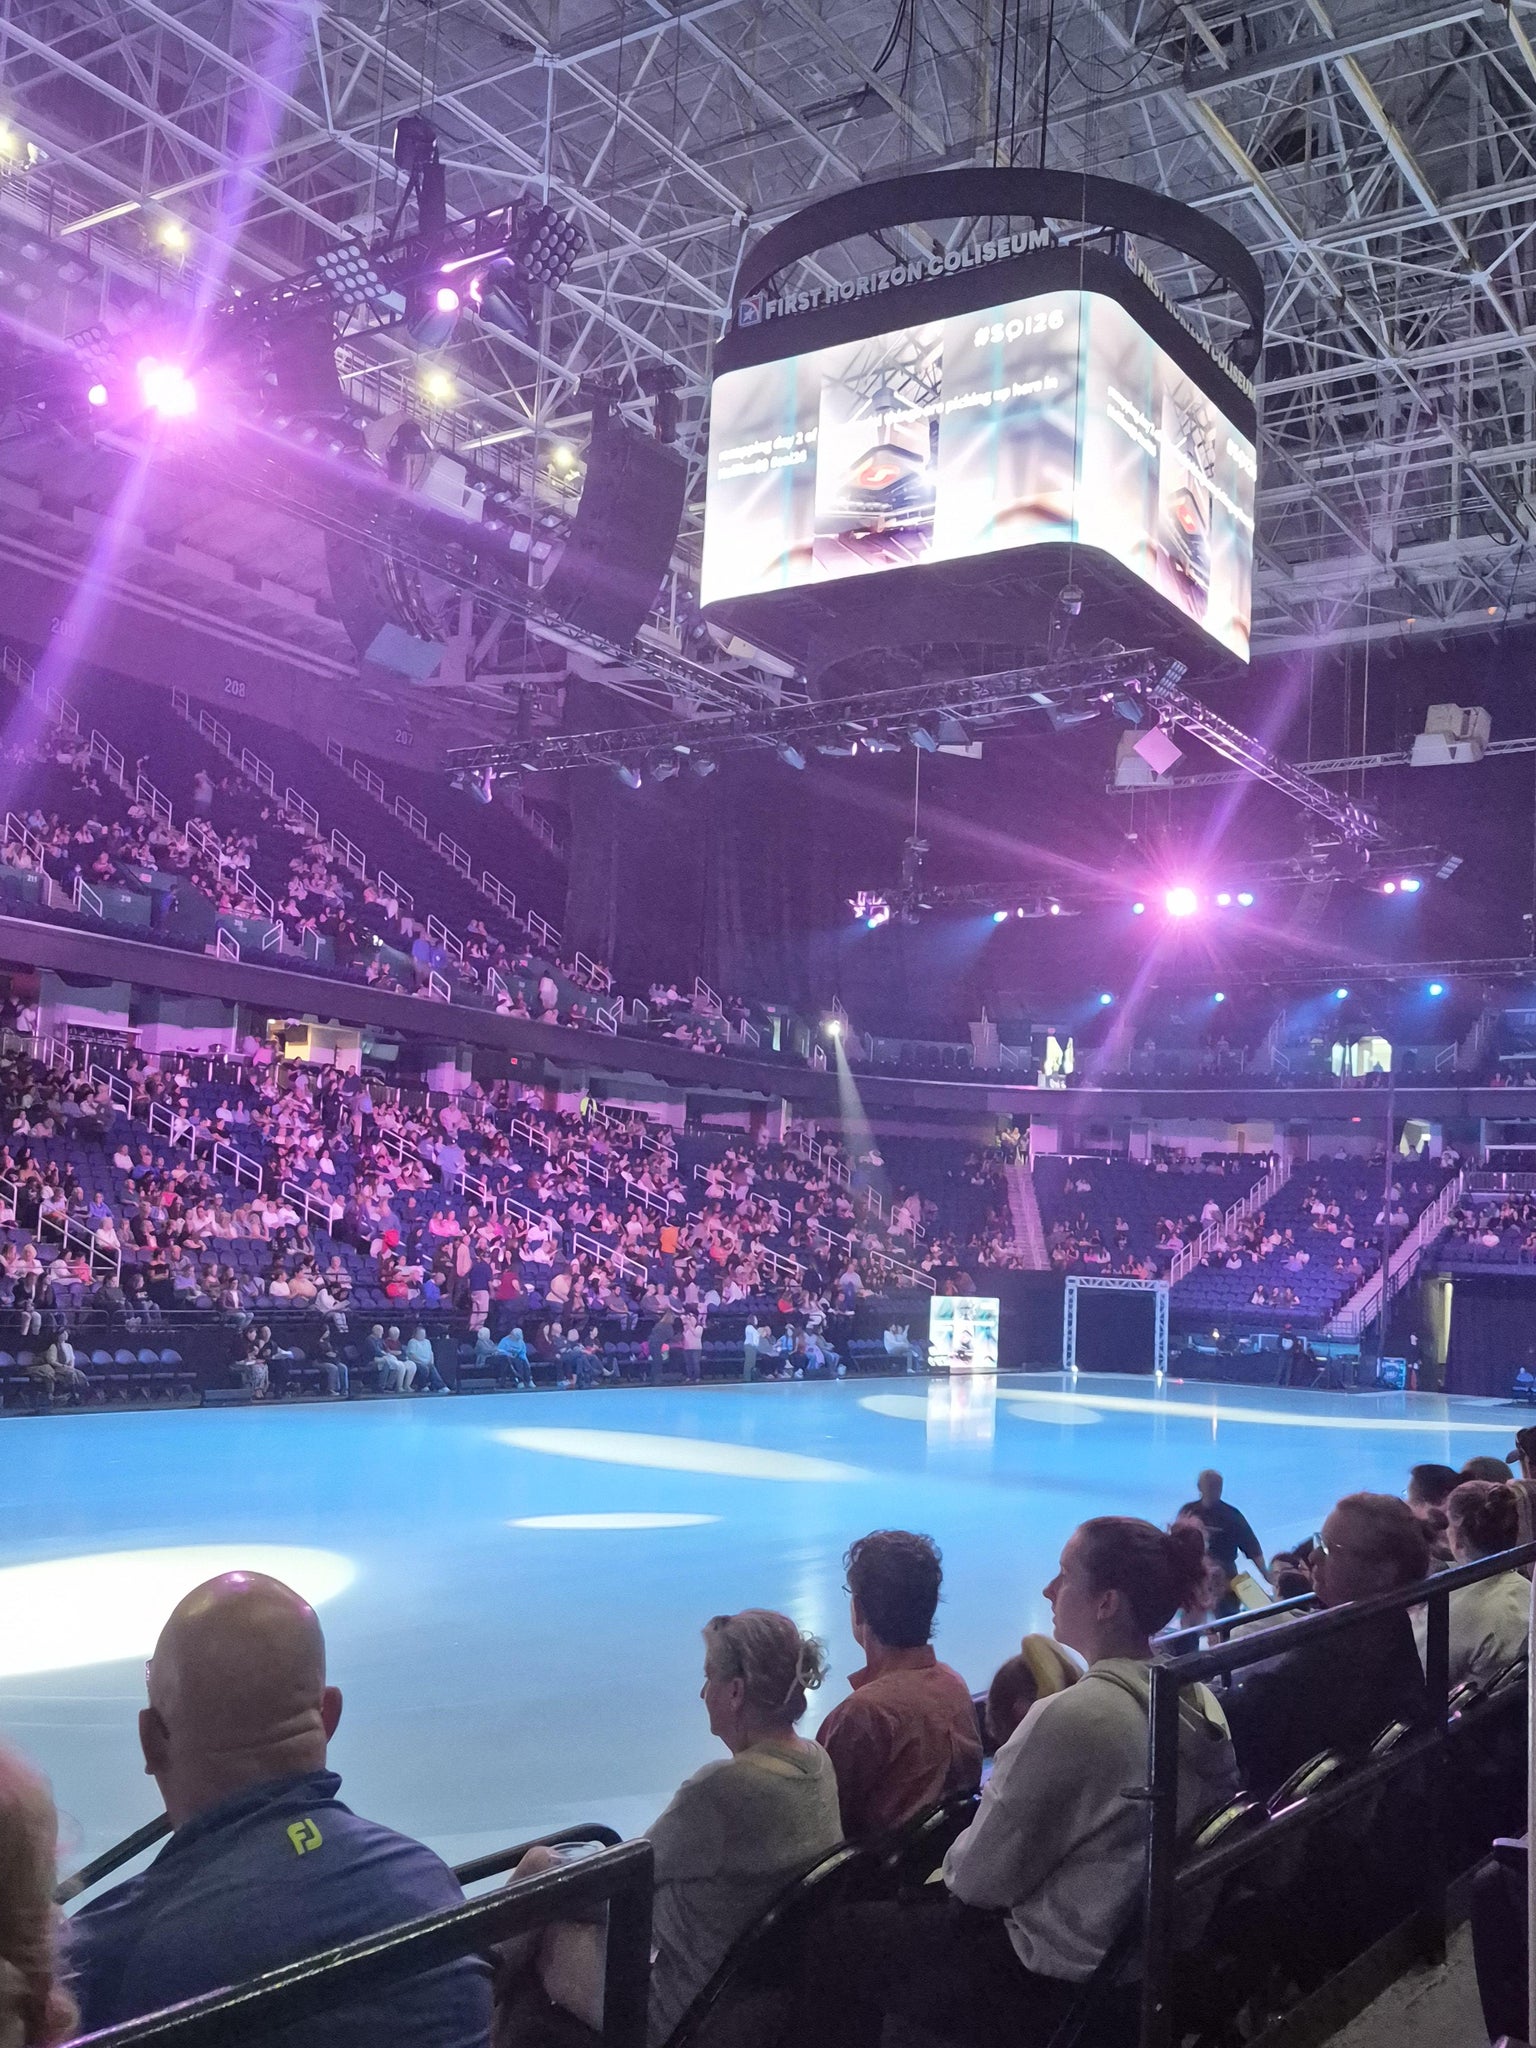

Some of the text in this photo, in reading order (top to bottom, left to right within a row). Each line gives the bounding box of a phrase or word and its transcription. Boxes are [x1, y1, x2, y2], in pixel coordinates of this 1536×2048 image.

[765, 227, 1050, 320] FIRST HORIZON COLISEUM
[1137, 258, 1166, 303] FIRST
[1210, 346, 1257, 404] COLISEUM
[224, 677, 246, 698] 208
[395, 729, 414, 745] 207
[286, 1818, 323, 1855] FJ
